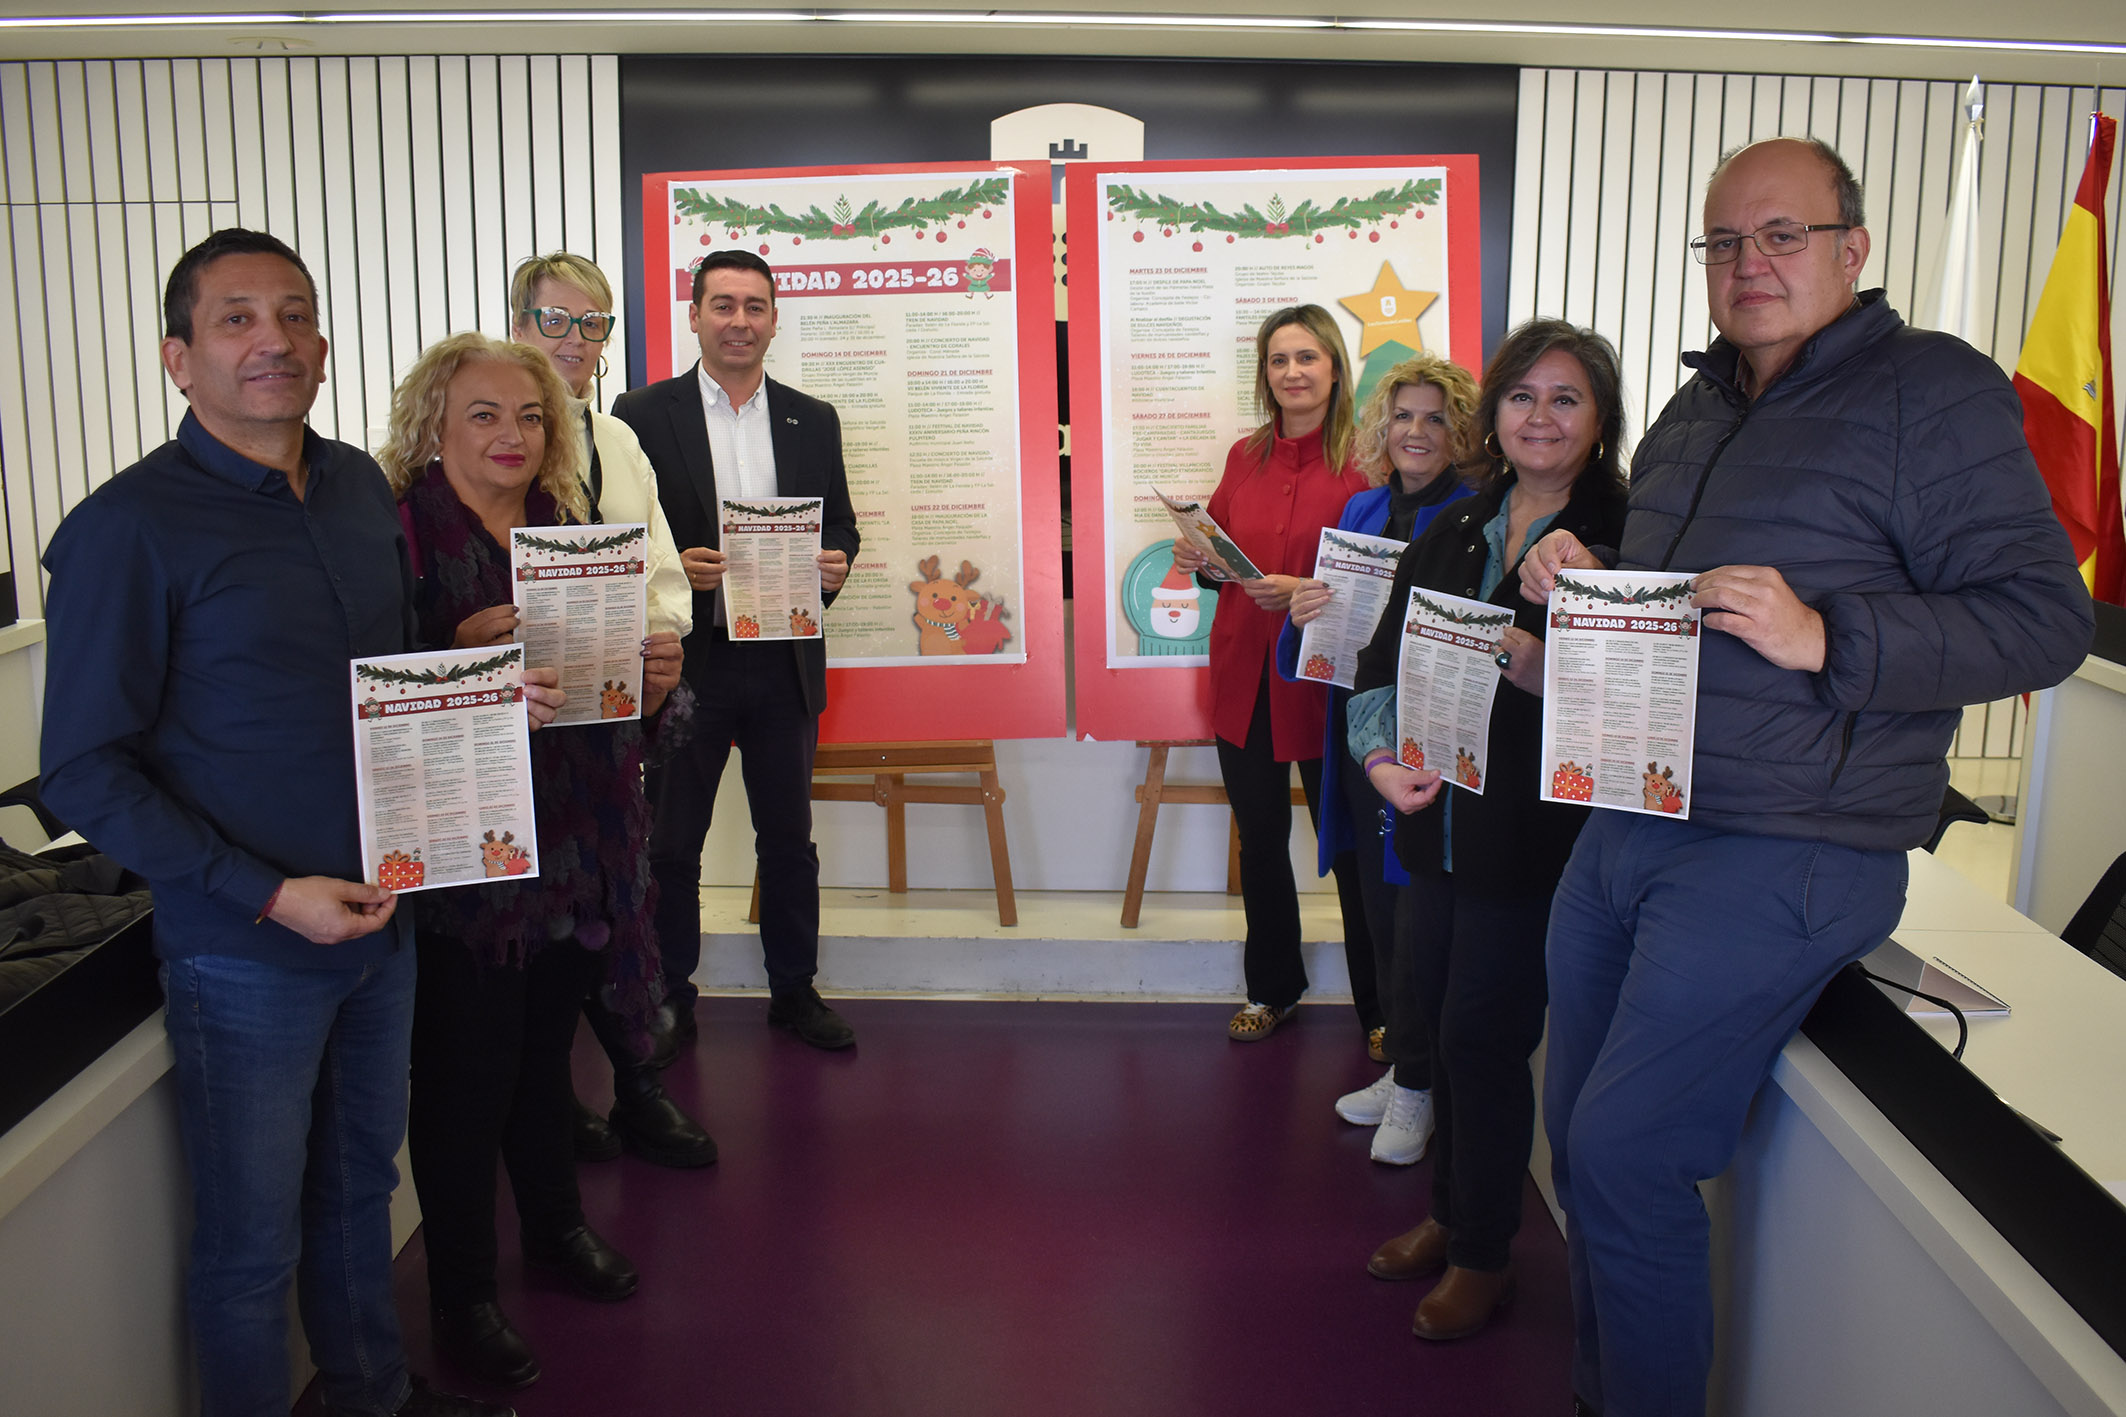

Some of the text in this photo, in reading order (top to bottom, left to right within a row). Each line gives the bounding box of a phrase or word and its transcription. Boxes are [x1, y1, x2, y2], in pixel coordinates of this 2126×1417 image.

[772, 267, 959, 292] IDAD 2025-26
[538, 564, 626, 578] NAVIDAD 2025-26
[1335, 561, 1395, 578] NAVIDAD 2025-
[1573, 617, 1678, 632] NAVIDAD 2025-26
[1420, 627, 1490, 651] NAVIDAD 2025-26
[385, 692, 499, 714] NAVIDAD 2025-26
